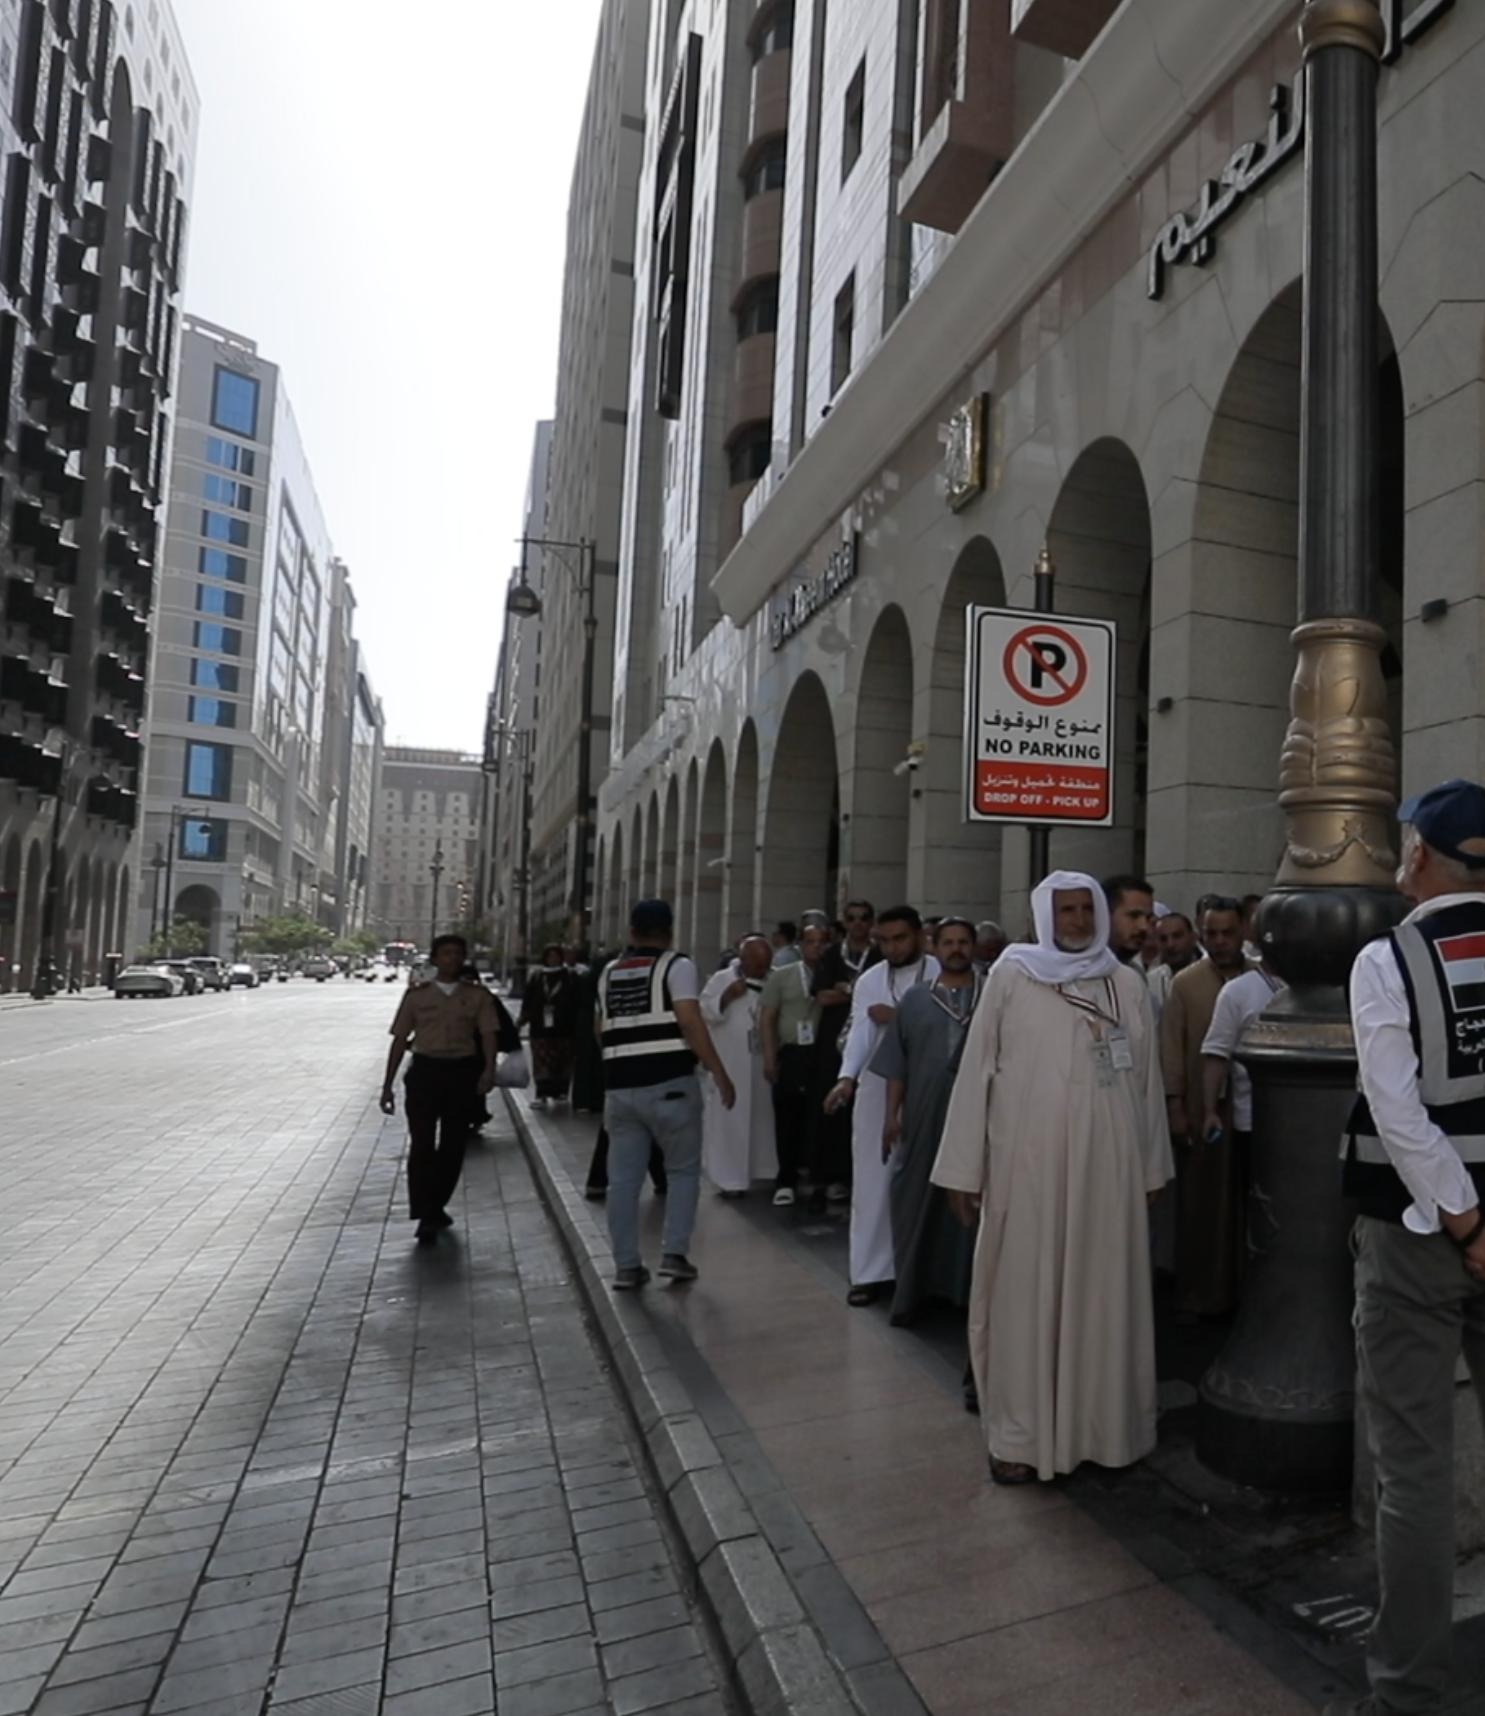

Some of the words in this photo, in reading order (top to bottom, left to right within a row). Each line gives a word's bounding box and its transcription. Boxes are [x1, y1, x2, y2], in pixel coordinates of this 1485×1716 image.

[1147, 66, 1306, 300] لنعيم
[983, 709, 1049, 734] الوقوف
[1054, 718, 1103, 738] ممنوع
[985, 738, 1013, 754] NO
[1019, 740, 1101, 760] PARKING
[984, 792, 1017, 802] DROP
[1019, 793, 1043, 804] OFF
[1052, 795, 1081, 807] PICK
[1083, 797, 1100, 807] UP
